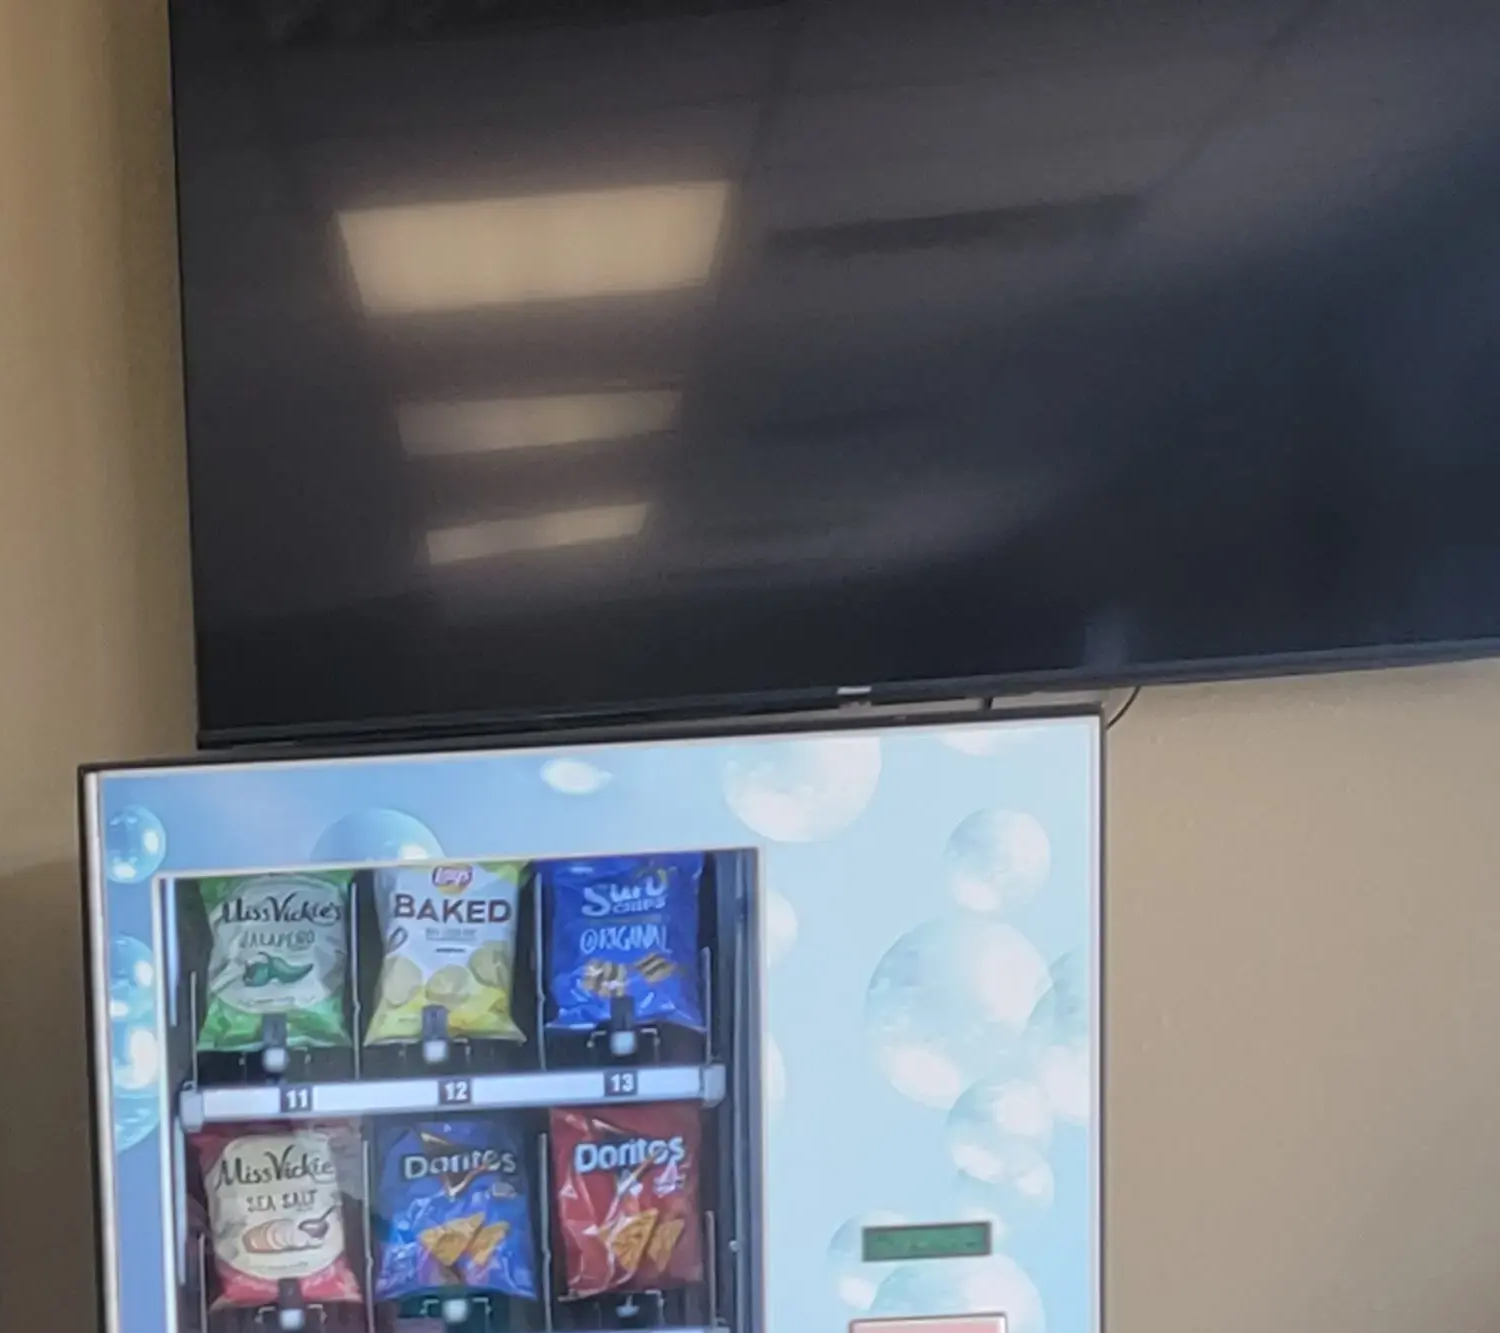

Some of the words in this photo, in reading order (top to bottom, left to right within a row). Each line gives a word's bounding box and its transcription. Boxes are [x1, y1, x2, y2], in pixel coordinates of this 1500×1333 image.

[393, 893, 512, 924] BAKED
[444, 1081, 468, 1101] 12
[610, 1073, 634, 1092] 13
[286, 1088, 308, 1109] 11
[404, 1149, 516, 1179] Doritos
[575, 1136, 685, 1174] Doritos
